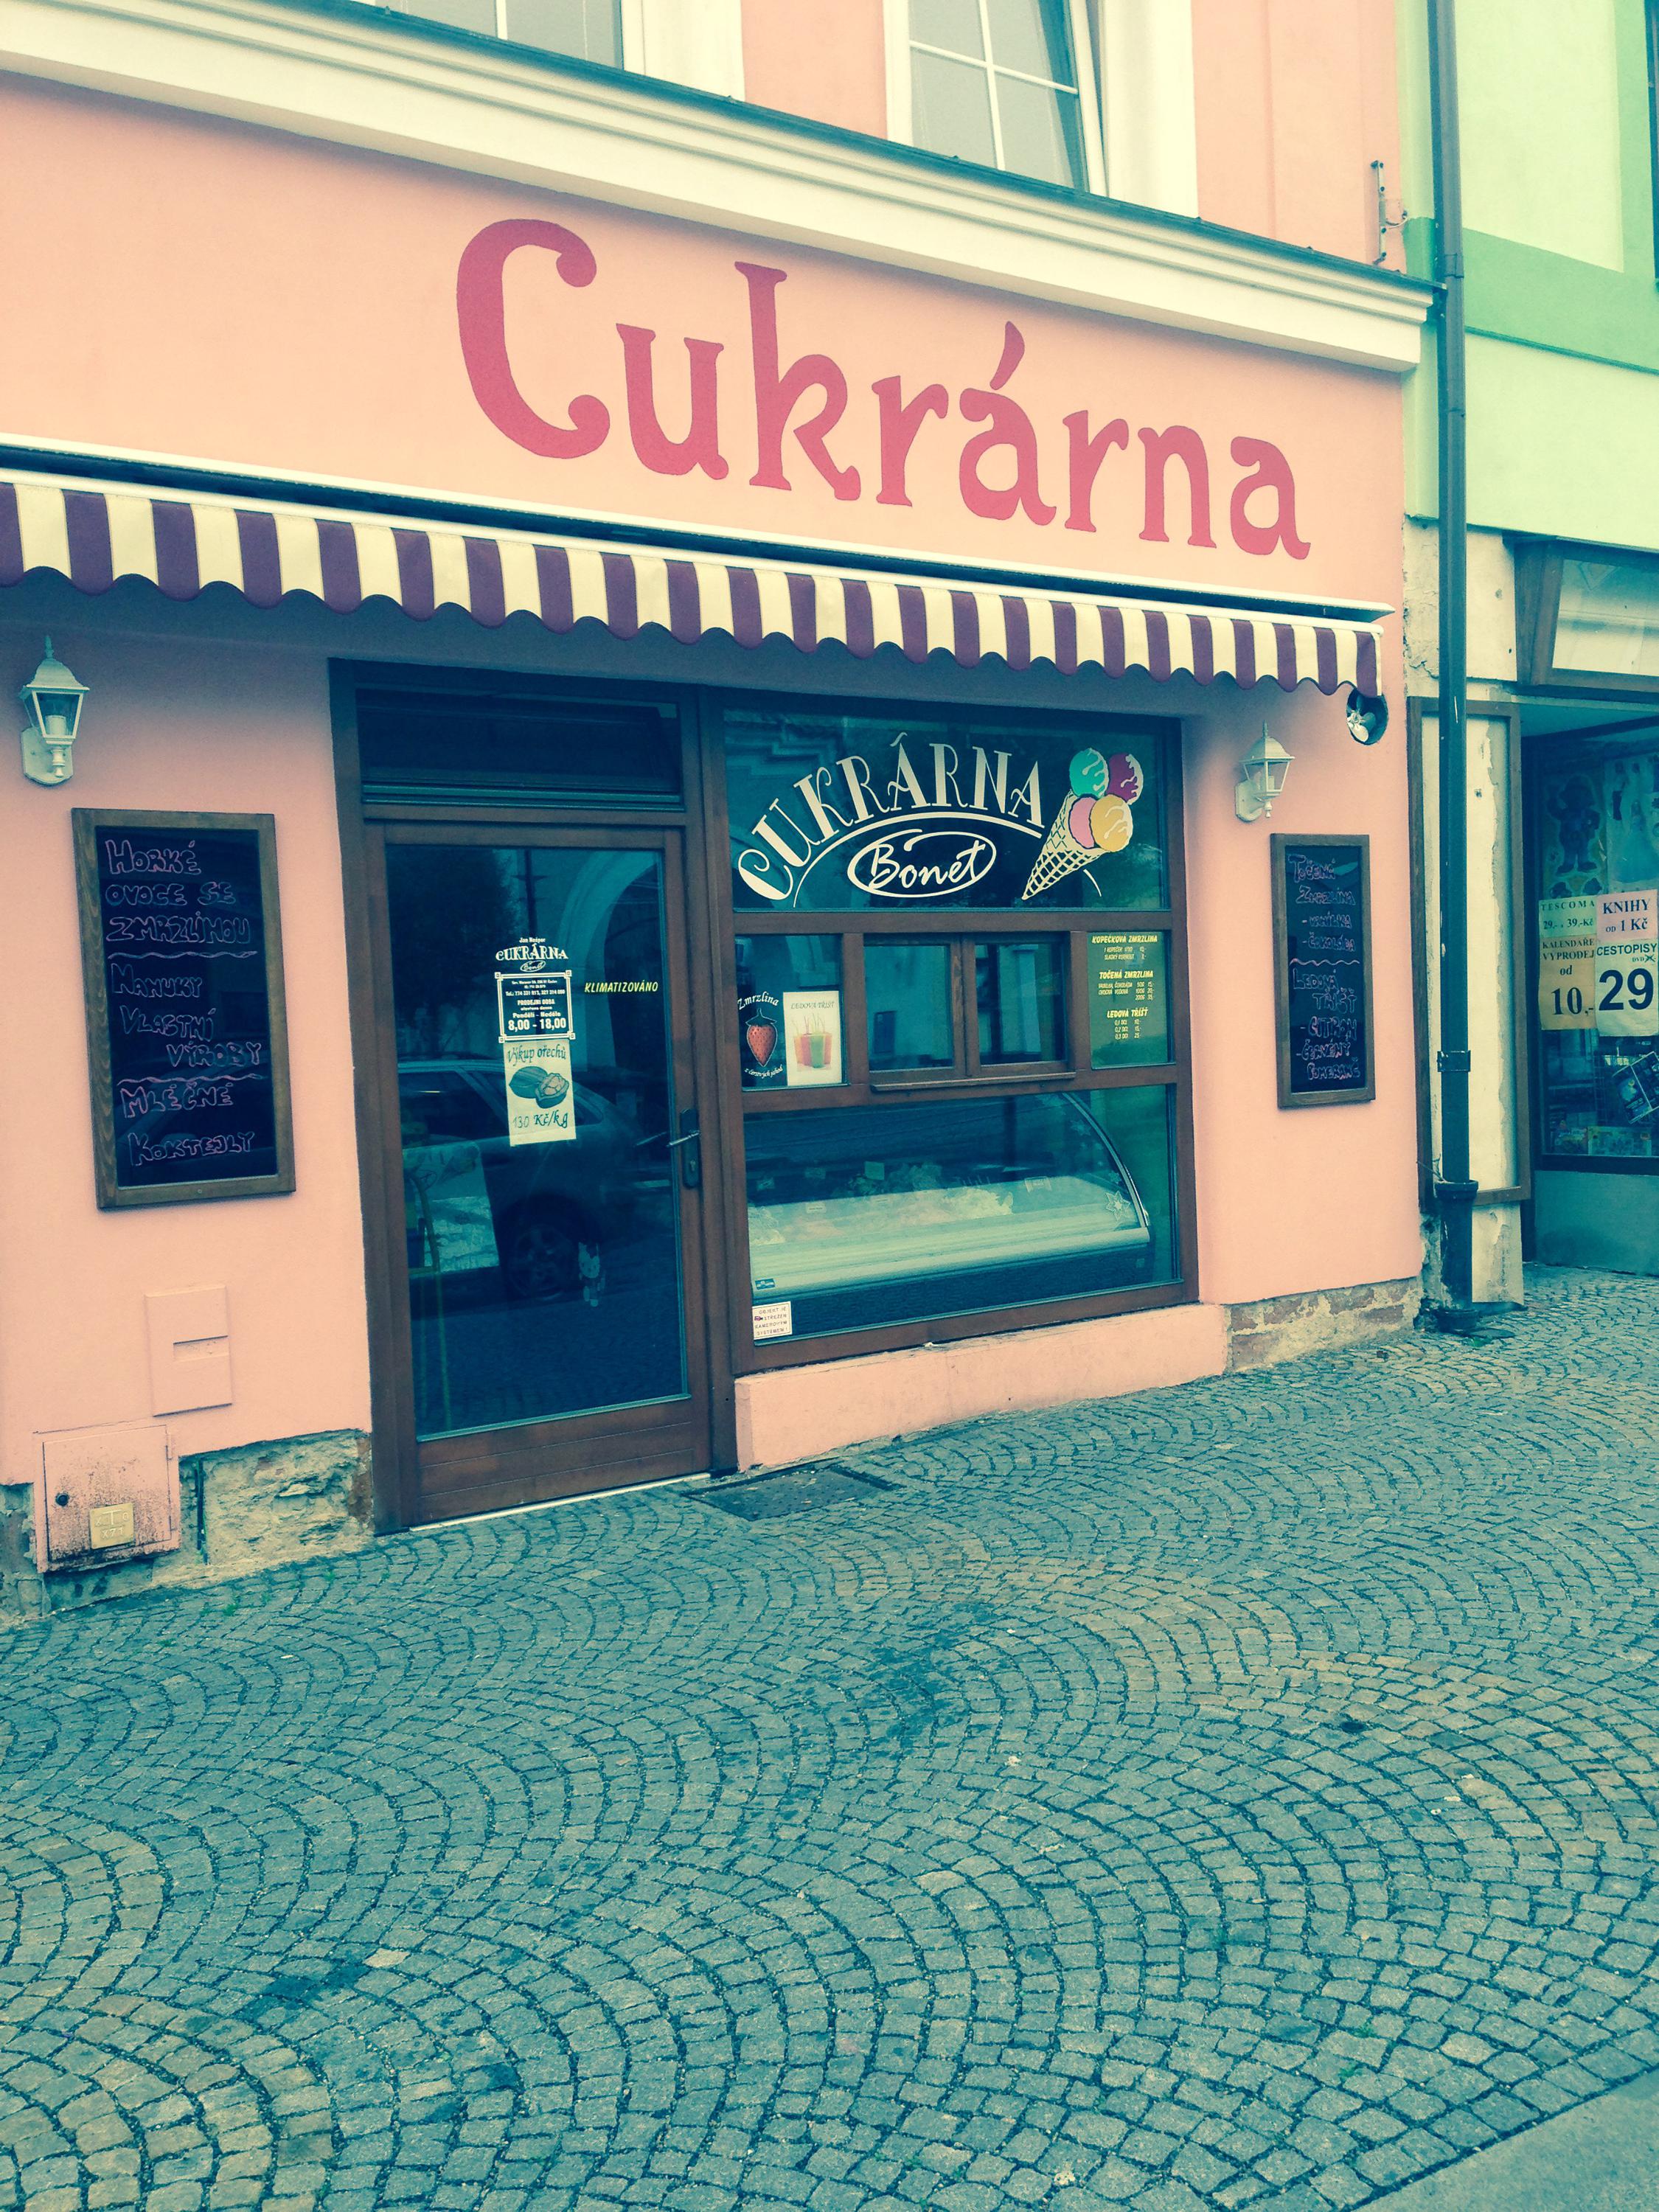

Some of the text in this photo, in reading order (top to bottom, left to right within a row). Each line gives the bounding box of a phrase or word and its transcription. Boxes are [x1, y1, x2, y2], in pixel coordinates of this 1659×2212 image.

[456, 218, 1311, 560] Cukrárna
[737, 732, 1046, 901] CUKRÁRNA
[105, 839, 201, 875] HORKÉ
[869, 829, 982, 889] Bonet
[105, 881, 237, 906] OVOCE SE
[1603, 898, 1650, 915] KNIHY
[1630, 917, 1648, 931] Kč
[1128, 935, 1158, 943] ZMRZLINA
[495, 943, 568, 961] CUKRÁRNA
[1596, 943, 1658, 956] CESTOPISY
[1099, 970, 1154, 980] TOČENÁ ZMRZLINA
[1559, 964, 1573, 975] od
[111, 962, 203, 998] NANUKY
[585, 979, 658, 992] KLIMATIZOVÁNO
[1599, 968, 1654, 1011] 29
[737, 991, 779, 1010] Zmrzlina
[1107, 1006, 1148, 1018] LEDOVÁ TŘÍŠŤ
[119, 1005, 217, 1042] VLASTNÍ
[508, 1020, 530, 1032] 8,00
[539, 1018, 567, 1031] 18,00
[166, 1040, 262, 1068] VÝROBY
[120, 1081, 234, 1119] MLÉČNÉ
[533, 1109, 568, 1129] Kč/kg
[127, 1131, 255, 1166] KOKTEJLY
